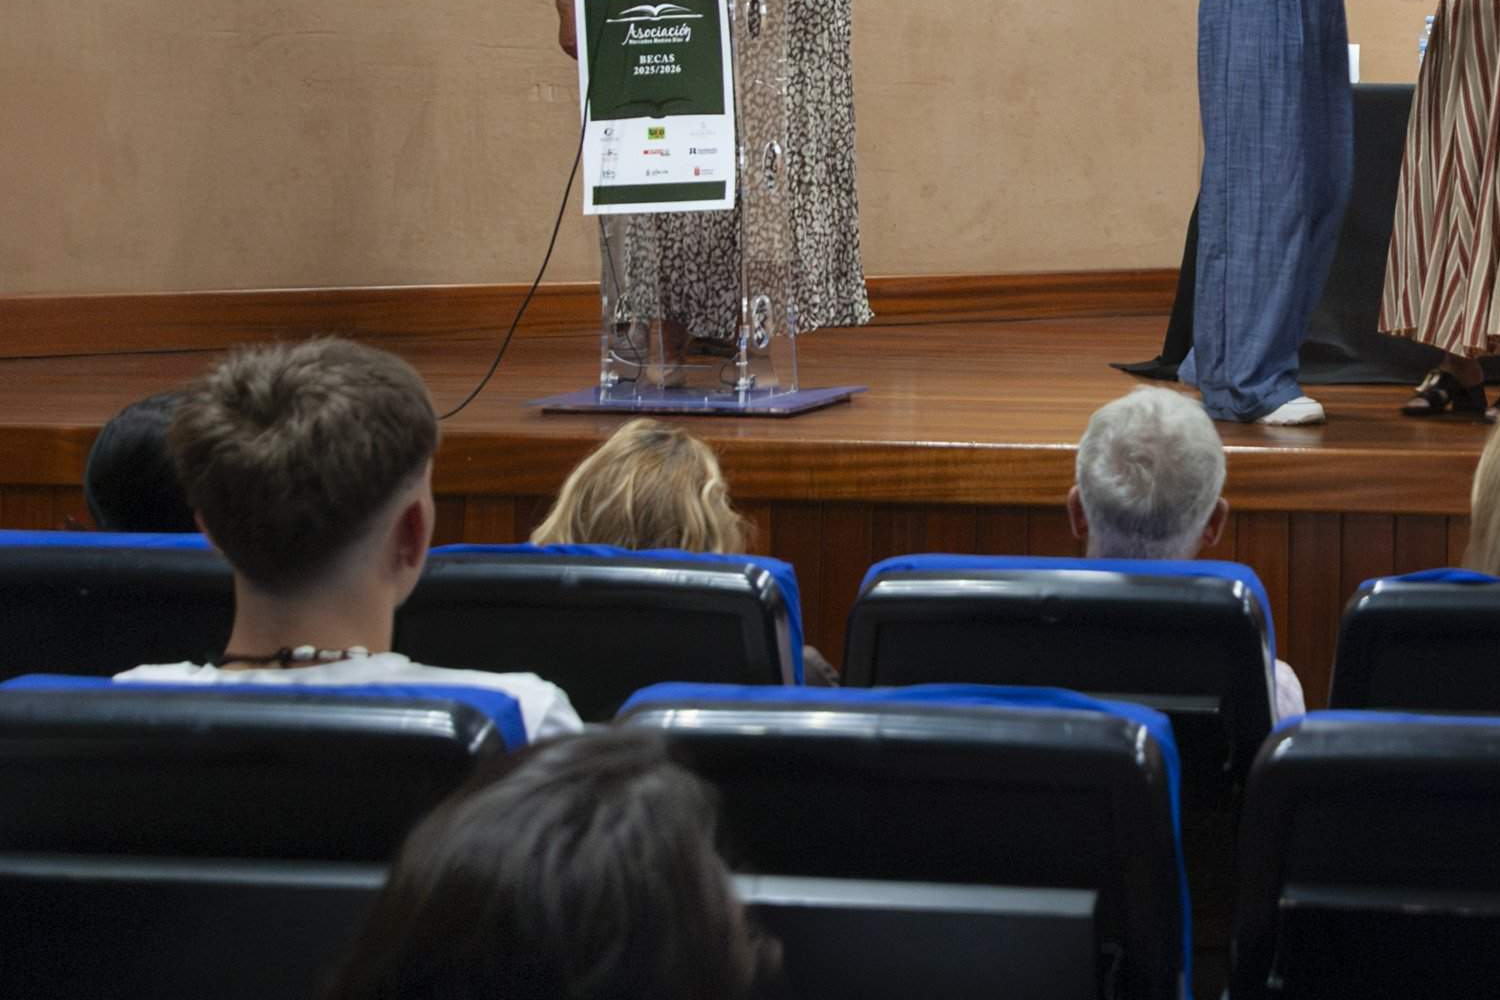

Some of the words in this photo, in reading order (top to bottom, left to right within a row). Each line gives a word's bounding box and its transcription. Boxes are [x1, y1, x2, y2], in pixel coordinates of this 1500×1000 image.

[621, 23, 691, 46] Asociación
[639, 54, 675, 64] BECAS
[633, 65, 682, 75] 2025/2026
